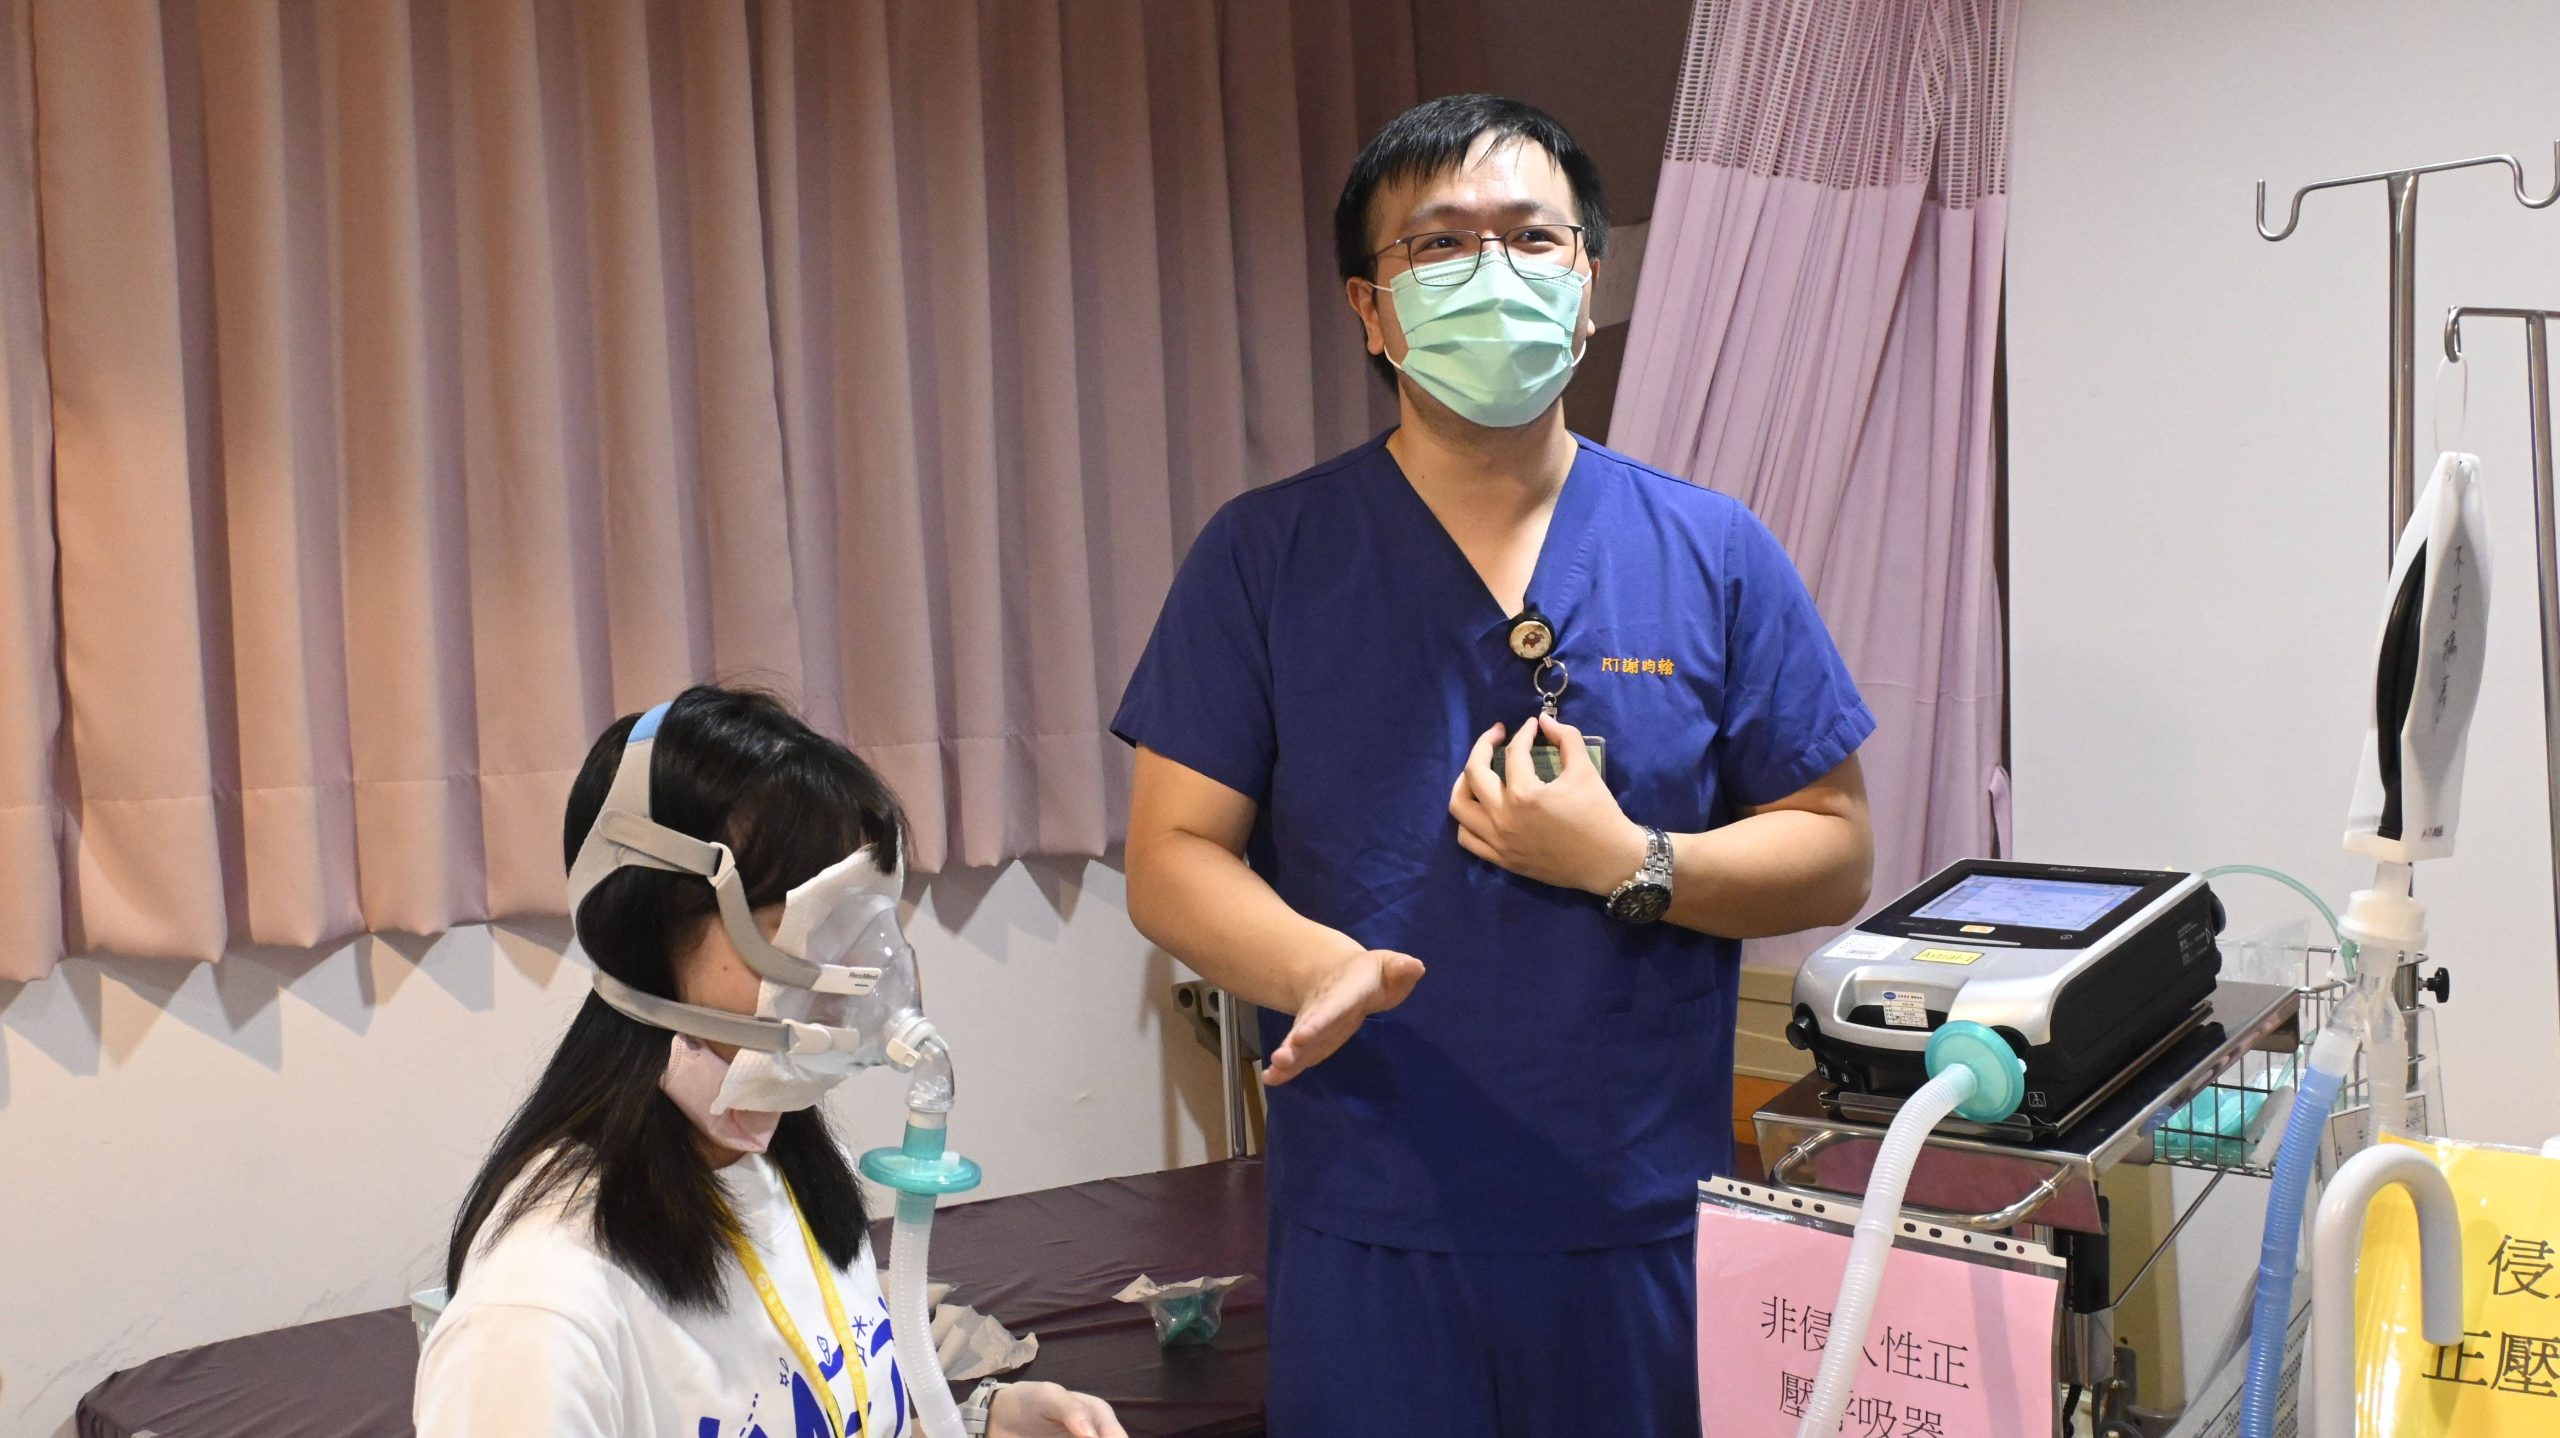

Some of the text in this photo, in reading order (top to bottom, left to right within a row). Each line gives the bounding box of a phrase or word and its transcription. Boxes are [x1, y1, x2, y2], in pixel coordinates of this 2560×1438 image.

[2487, 1234, 2560, 1300] 侵
[2421, 1330, 2560, 1398] 正壓
[1779, 1371, 1944, 1438] 壓吸器
